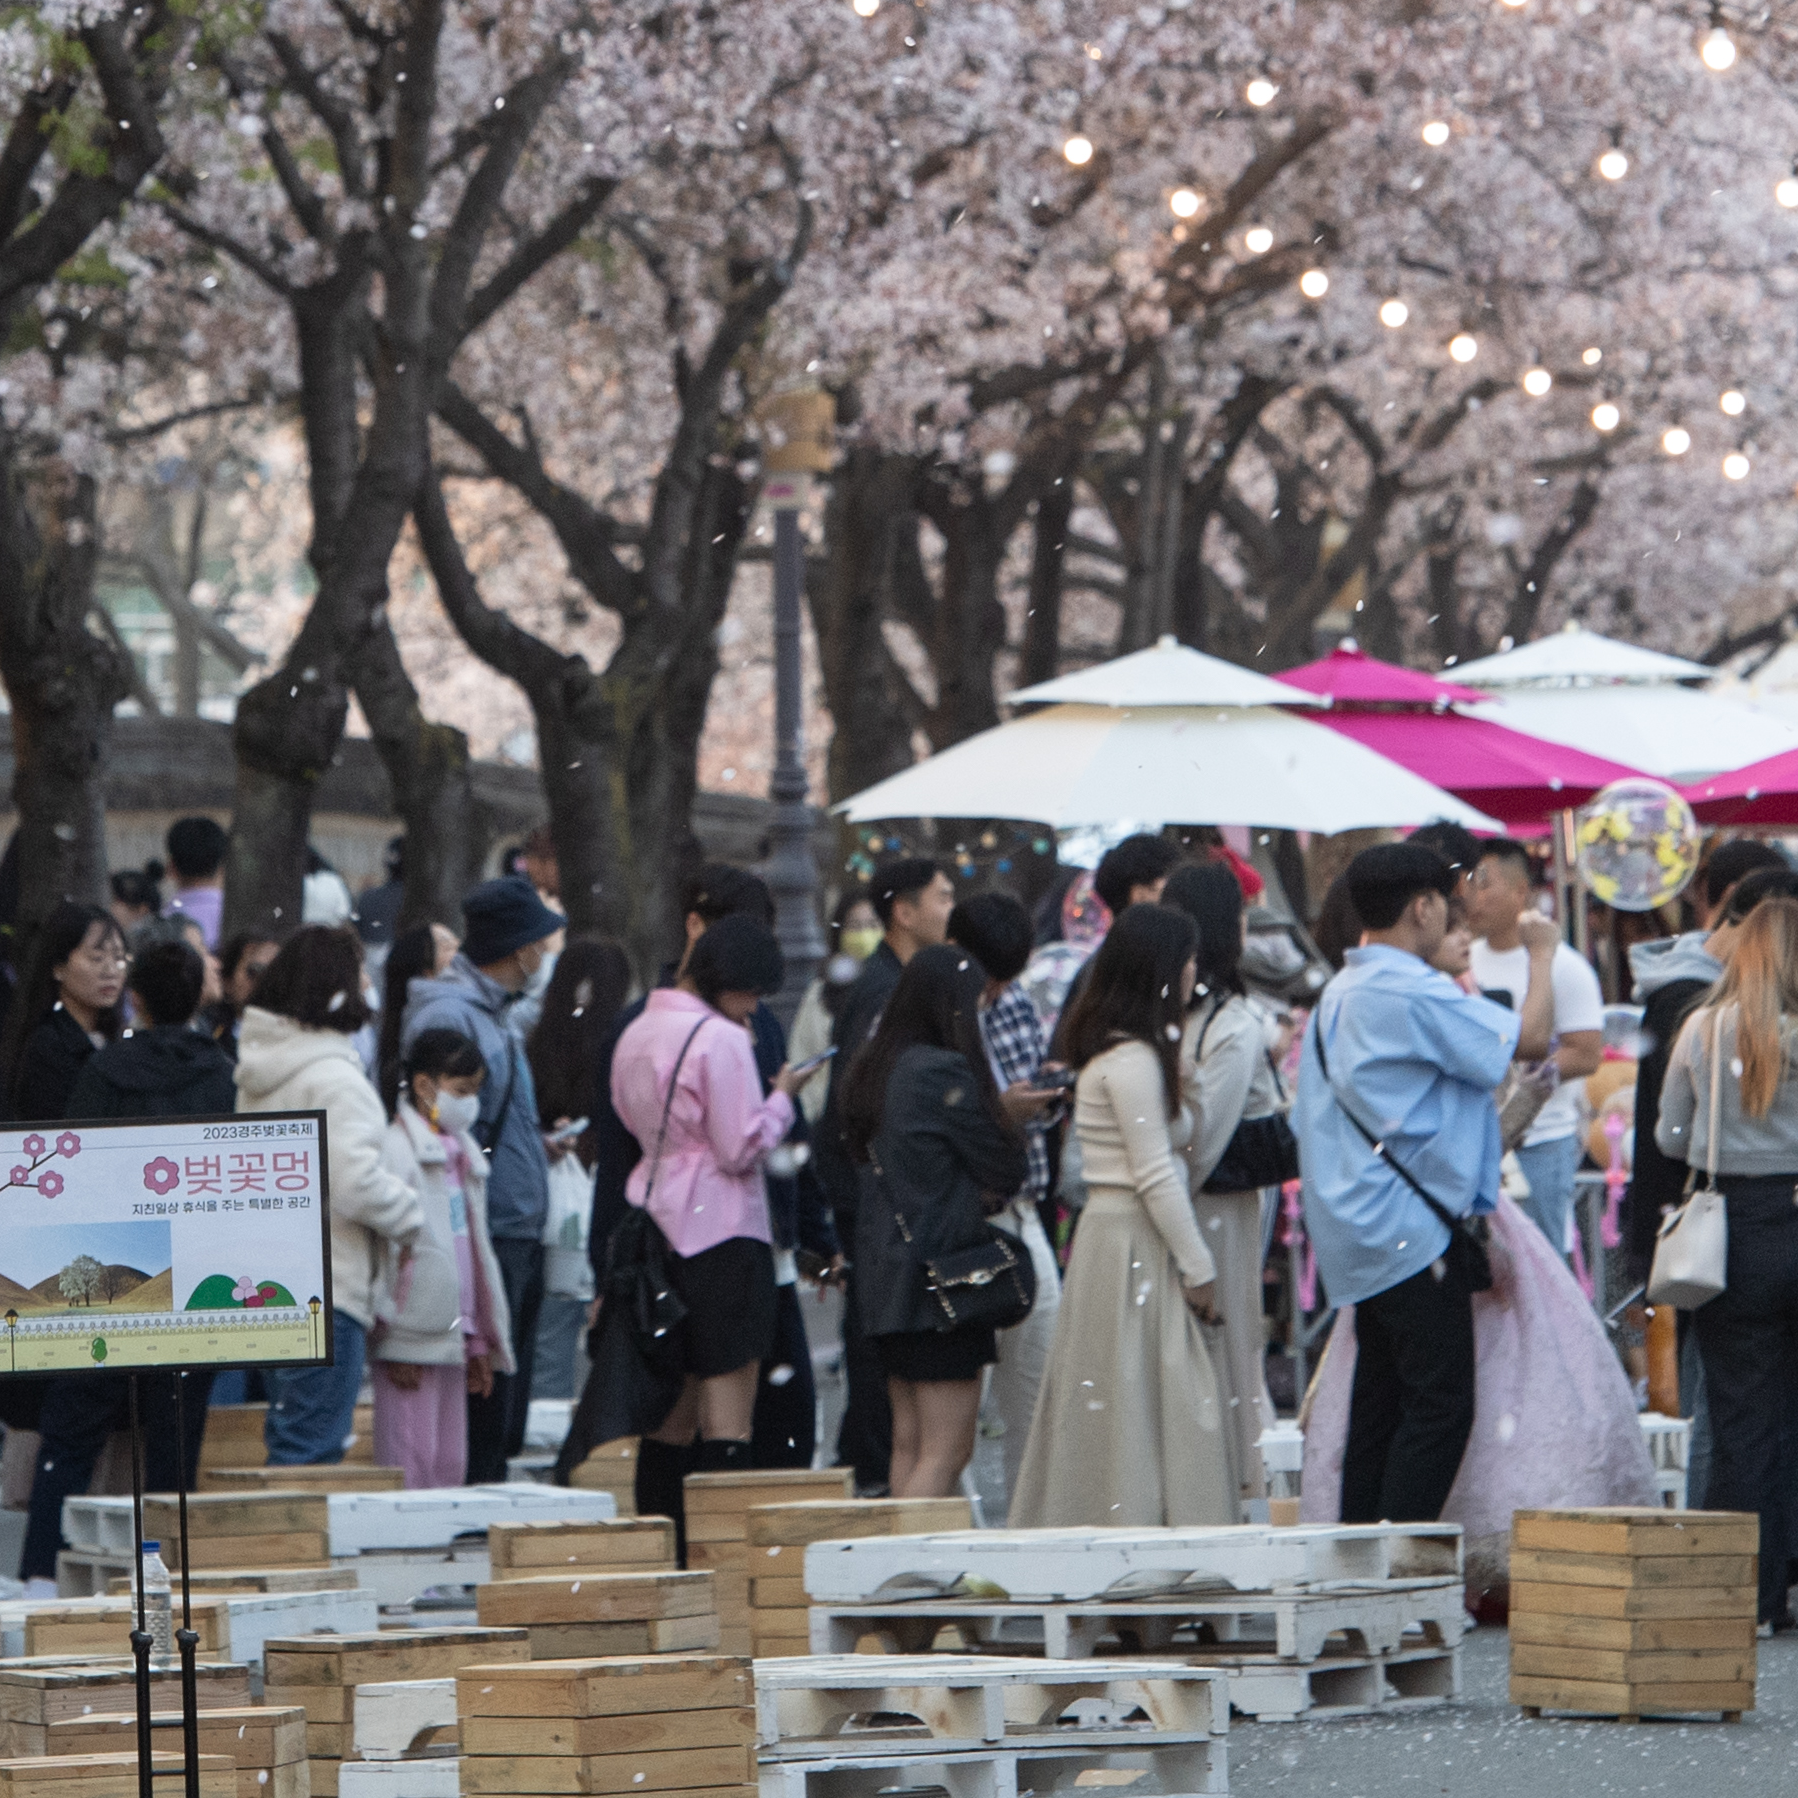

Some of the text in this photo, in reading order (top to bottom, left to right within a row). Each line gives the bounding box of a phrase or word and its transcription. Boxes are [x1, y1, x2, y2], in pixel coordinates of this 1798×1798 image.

[203, 1123, 313, 1139] 2023경주벚꽃축제
[184, 1151, 310, 1195] 벚꽃멍
[132, 1196, 311, 1215] 지친일상 휴식을 주는 특별한 공간
